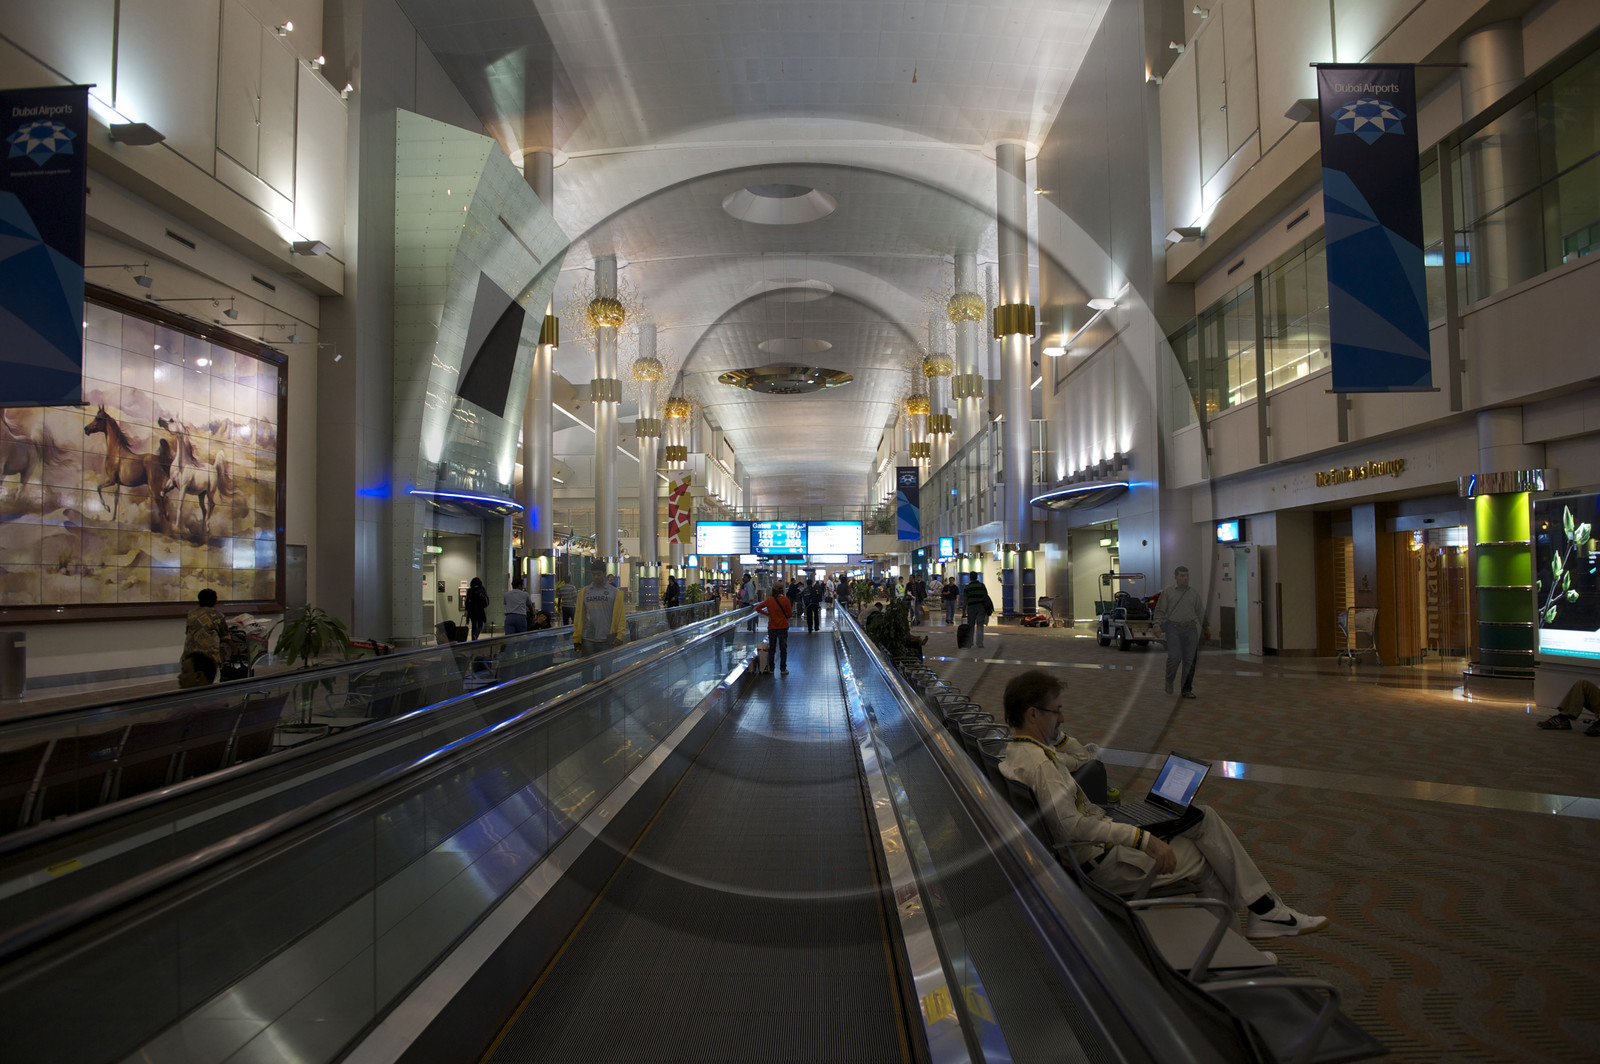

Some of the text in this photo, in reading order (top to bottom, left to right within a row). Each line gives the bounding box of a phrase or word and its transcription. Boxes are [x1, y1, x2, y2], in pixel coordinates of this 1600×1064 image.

[1334, 83, 1399, 95] Dubai Airports
[12, 104, 73, 117] Dubai Airports
[1315, 458, 1405, 487] The Emirates Lounge
